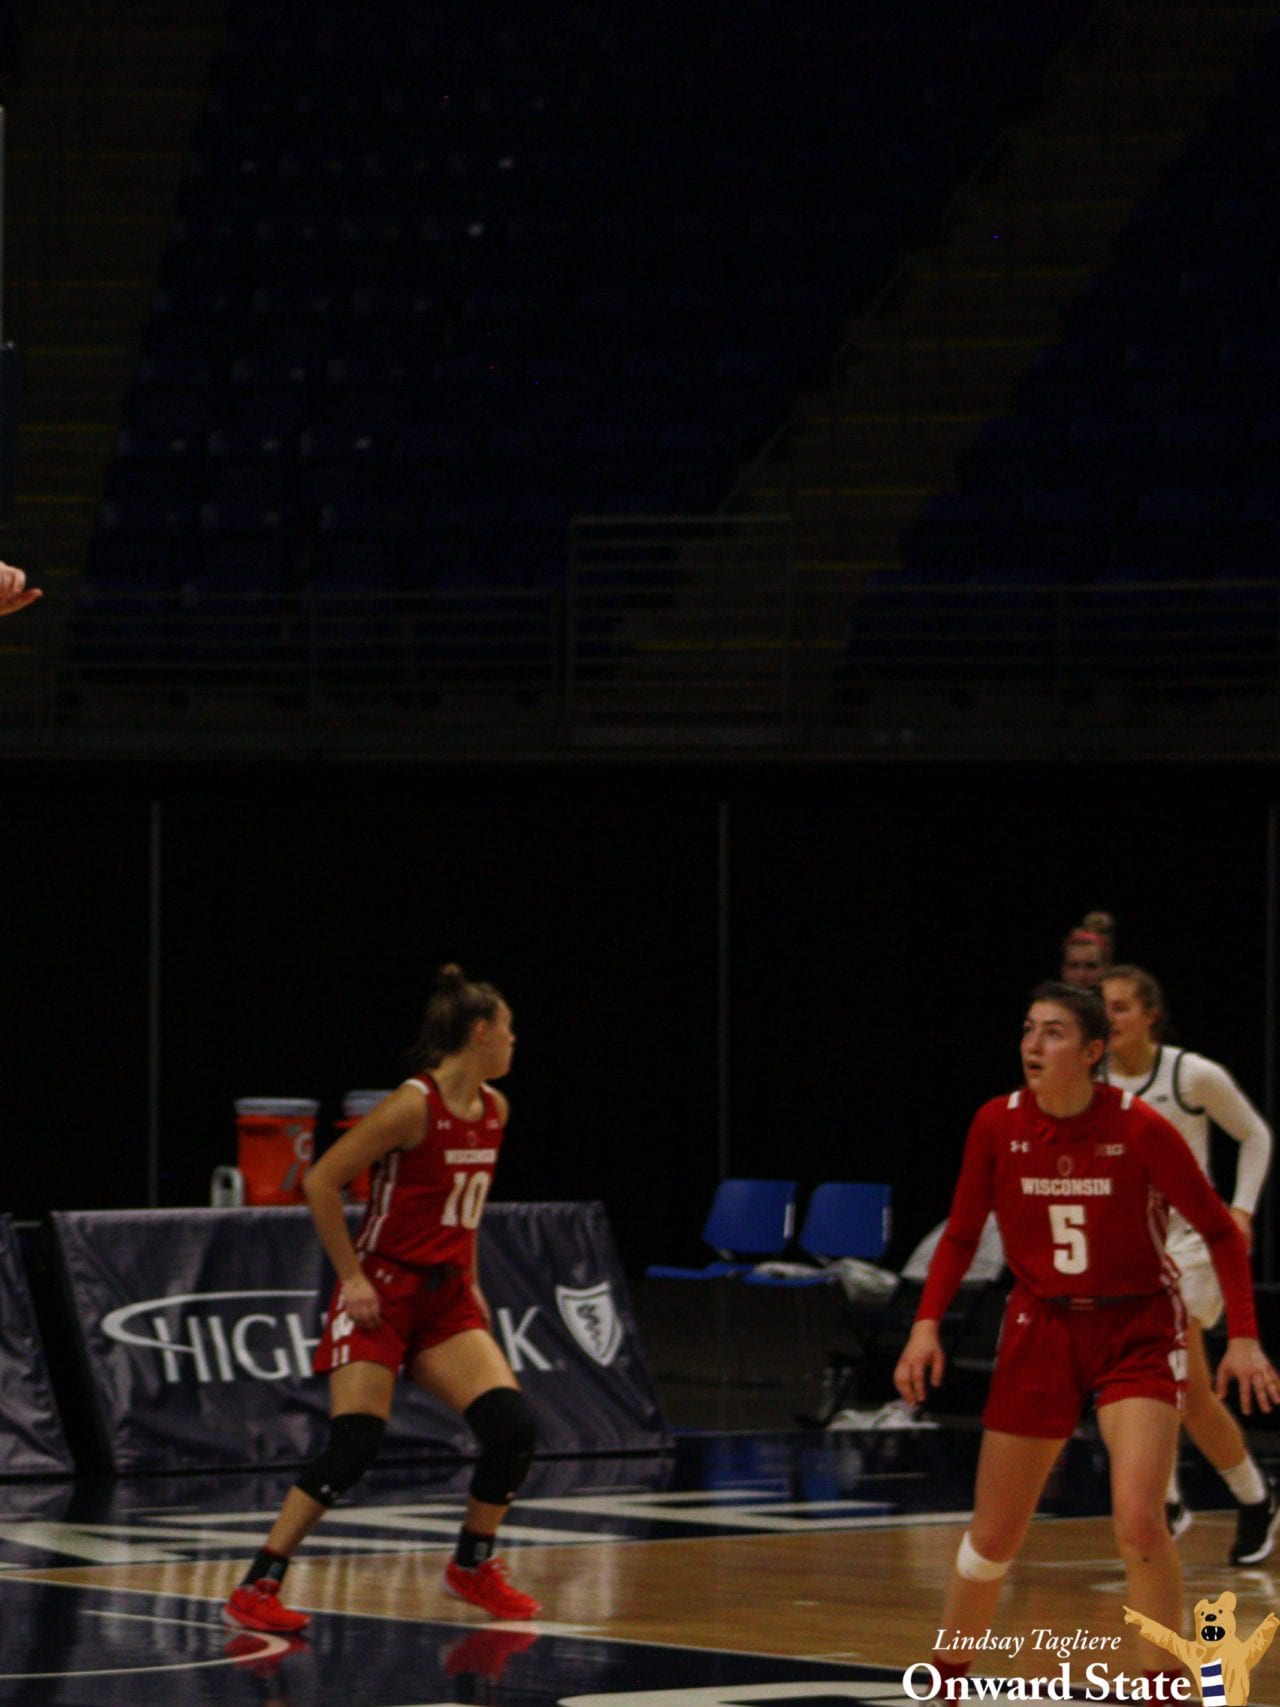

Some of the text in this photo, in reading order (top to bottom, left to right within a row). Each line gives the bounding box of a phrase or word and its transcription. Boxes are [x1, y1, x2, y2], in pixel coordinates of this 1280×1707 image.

[440, 1171, 492, 1230] 10
[1020, 1176, 1112, 1197] WISCONSIN
[1048, 1204, 1090, 1275] 5
